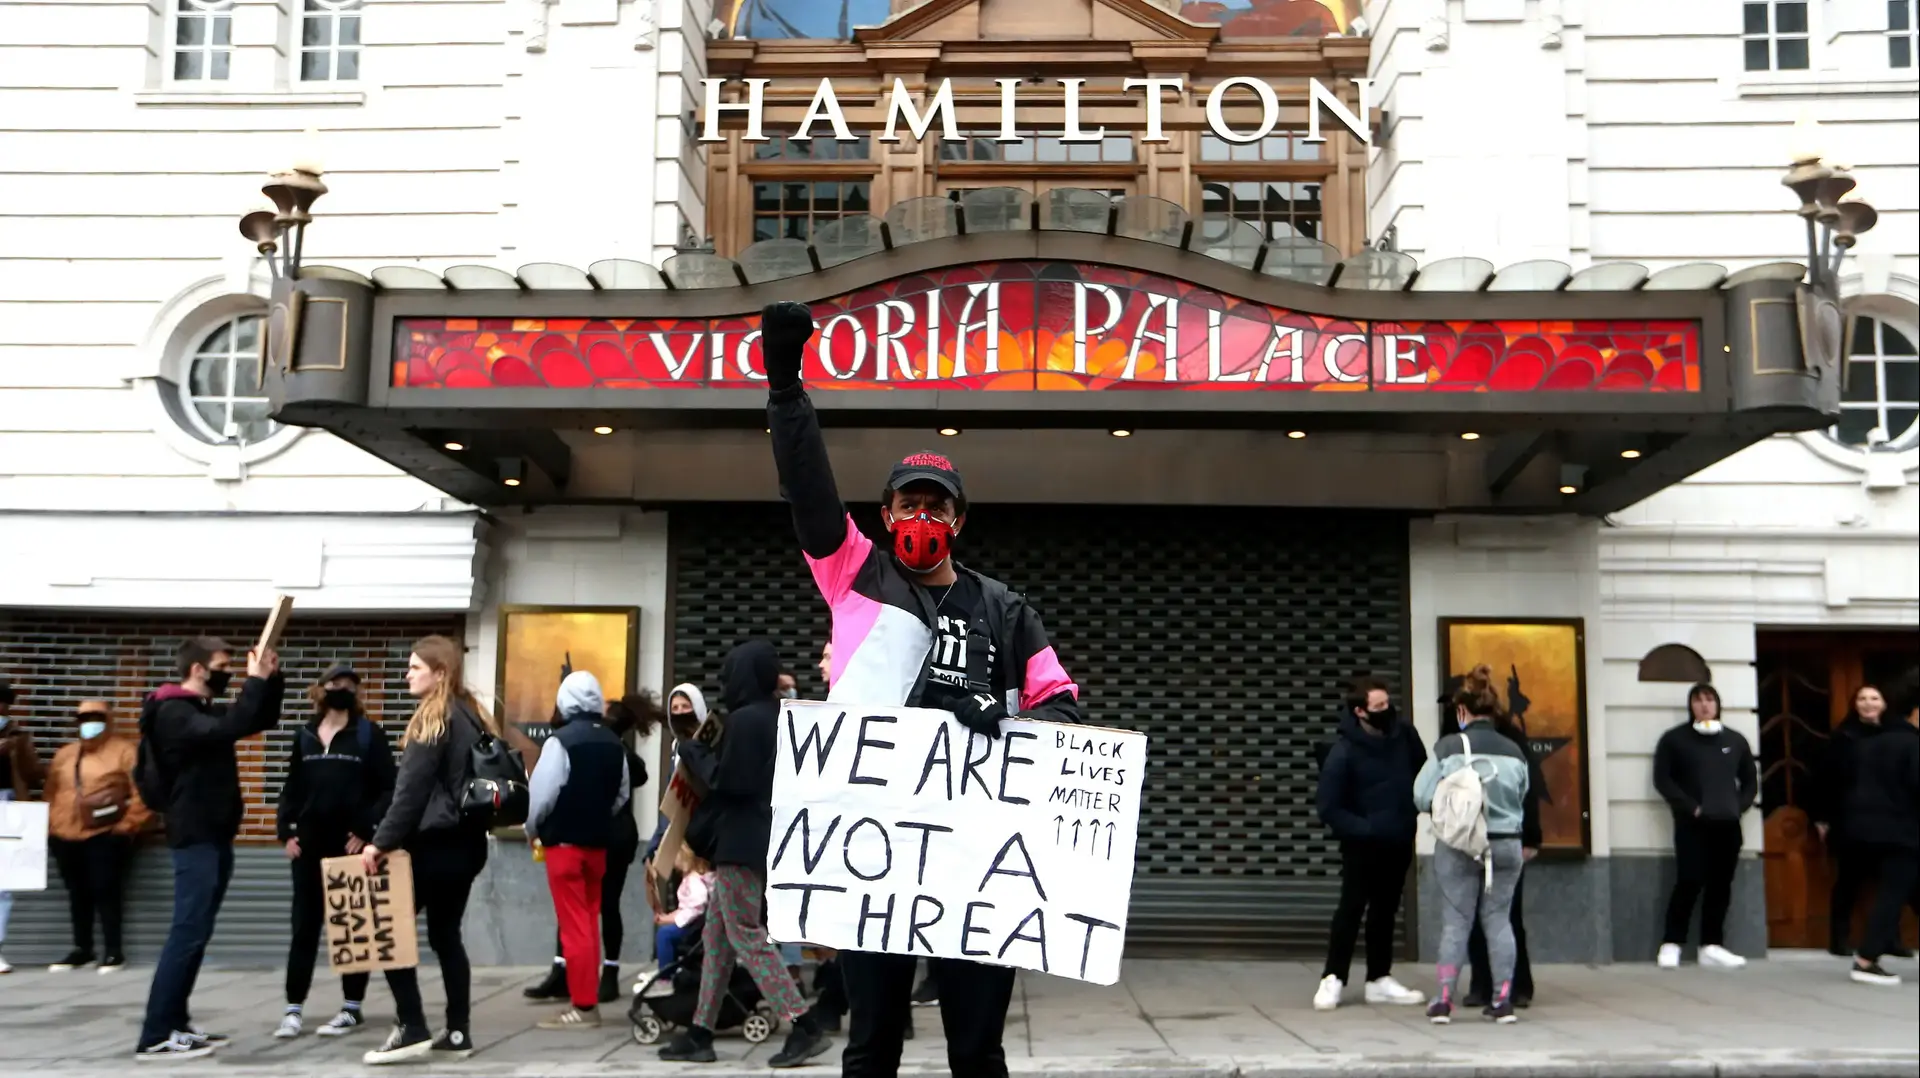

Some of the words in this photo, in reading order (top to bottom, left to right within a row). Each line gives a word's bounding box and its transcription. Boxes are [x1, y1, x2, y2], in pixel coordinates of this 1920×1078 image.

[698, 76, 1376, 143] HAMILTON
[648, 282, 1001, 381] VICORIA
[1074, 282, 1427, 383] PALACE
[787, 710, 898, 786] WE
[914, 721, 1038, 805] ARE
[1056, 730, 1125, 759] BLACK
[1060, 757, 1126, 786] LIVES
[1048, 785, 1121, 813] MATTER
[771, 808, 953, 885] NOT
[978, 832, 1048, 901] A
[327, 870, 353, 966] BLACK
[347, 875, 370, 962] LIVES
[771, 883, 1121, 979] THREAT
